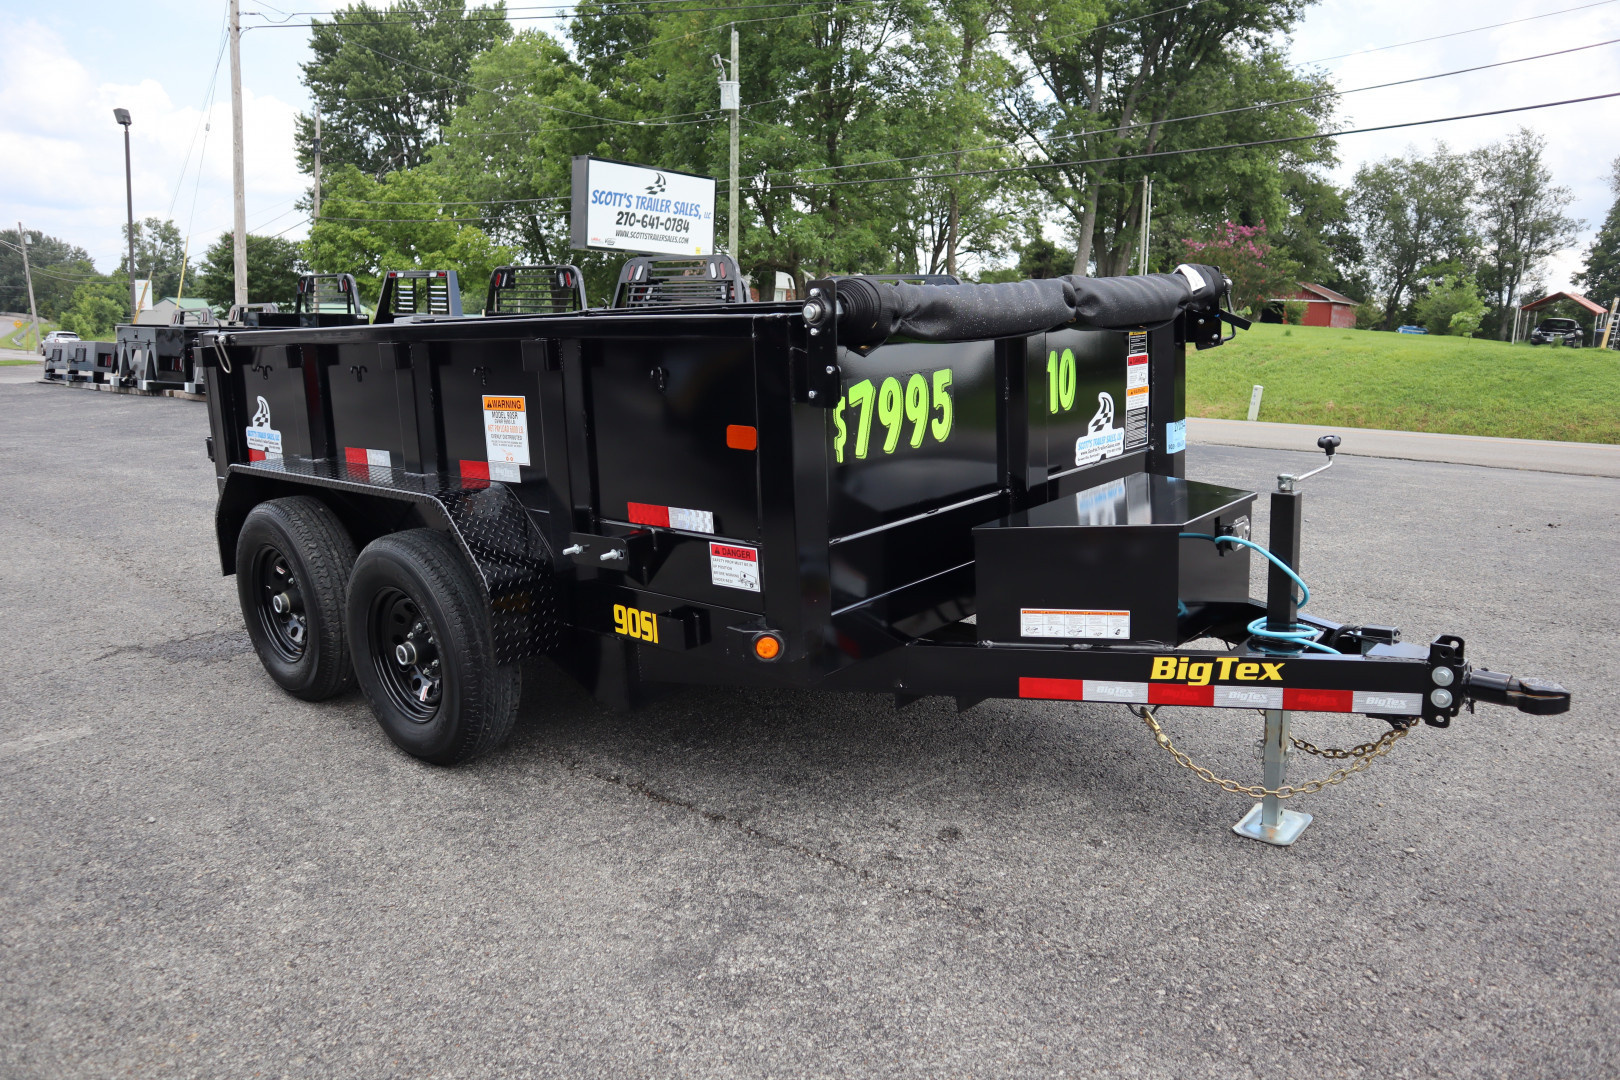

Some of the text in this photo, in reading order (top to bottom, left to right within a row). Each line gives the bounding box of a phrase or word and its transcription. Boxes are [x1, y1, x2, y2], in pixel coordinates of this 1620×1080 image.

[591, 189, 712, 219] SCOTT'S TRAILER SALES, LLC
[615, 211, 690, 233] 270-641-0784
[615, 229, 689, 244] WWW.SCOTTSTRAILERSALES.COM
[1047, 348, 1077, 414] 10
[492, 399, 522, 410] WARNING
[833, 368, 953, 464] $7995
[722, 548, 751, 558] DANGER
